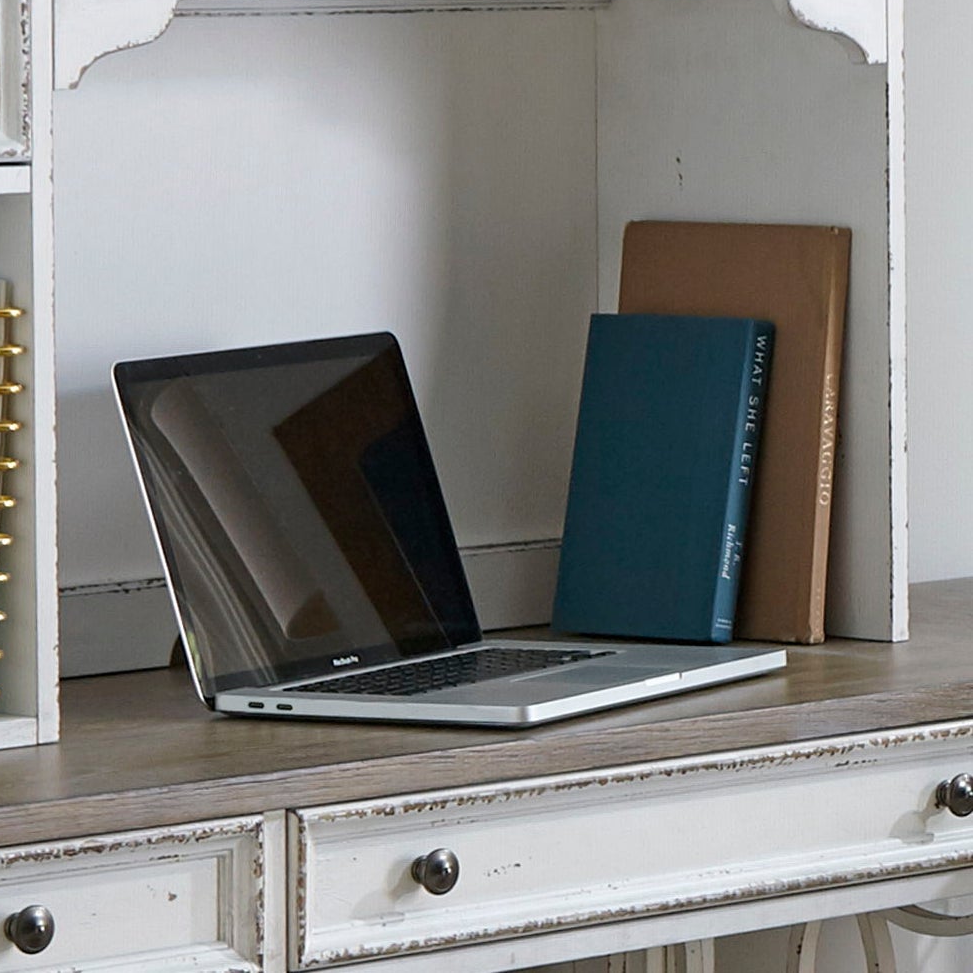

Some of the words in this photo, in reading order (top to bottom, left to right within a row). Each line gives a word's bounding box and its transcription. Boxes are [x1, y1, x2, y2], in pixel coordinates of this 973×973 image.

[750, 335, 767, 386] WHAT
[744, 395, 760, 432] SHE
[819, 372, 836, 506] CARAVAGGIO
[738, 441, 753, 486] LEFT
[721, 524, 736, 579] Richmond
